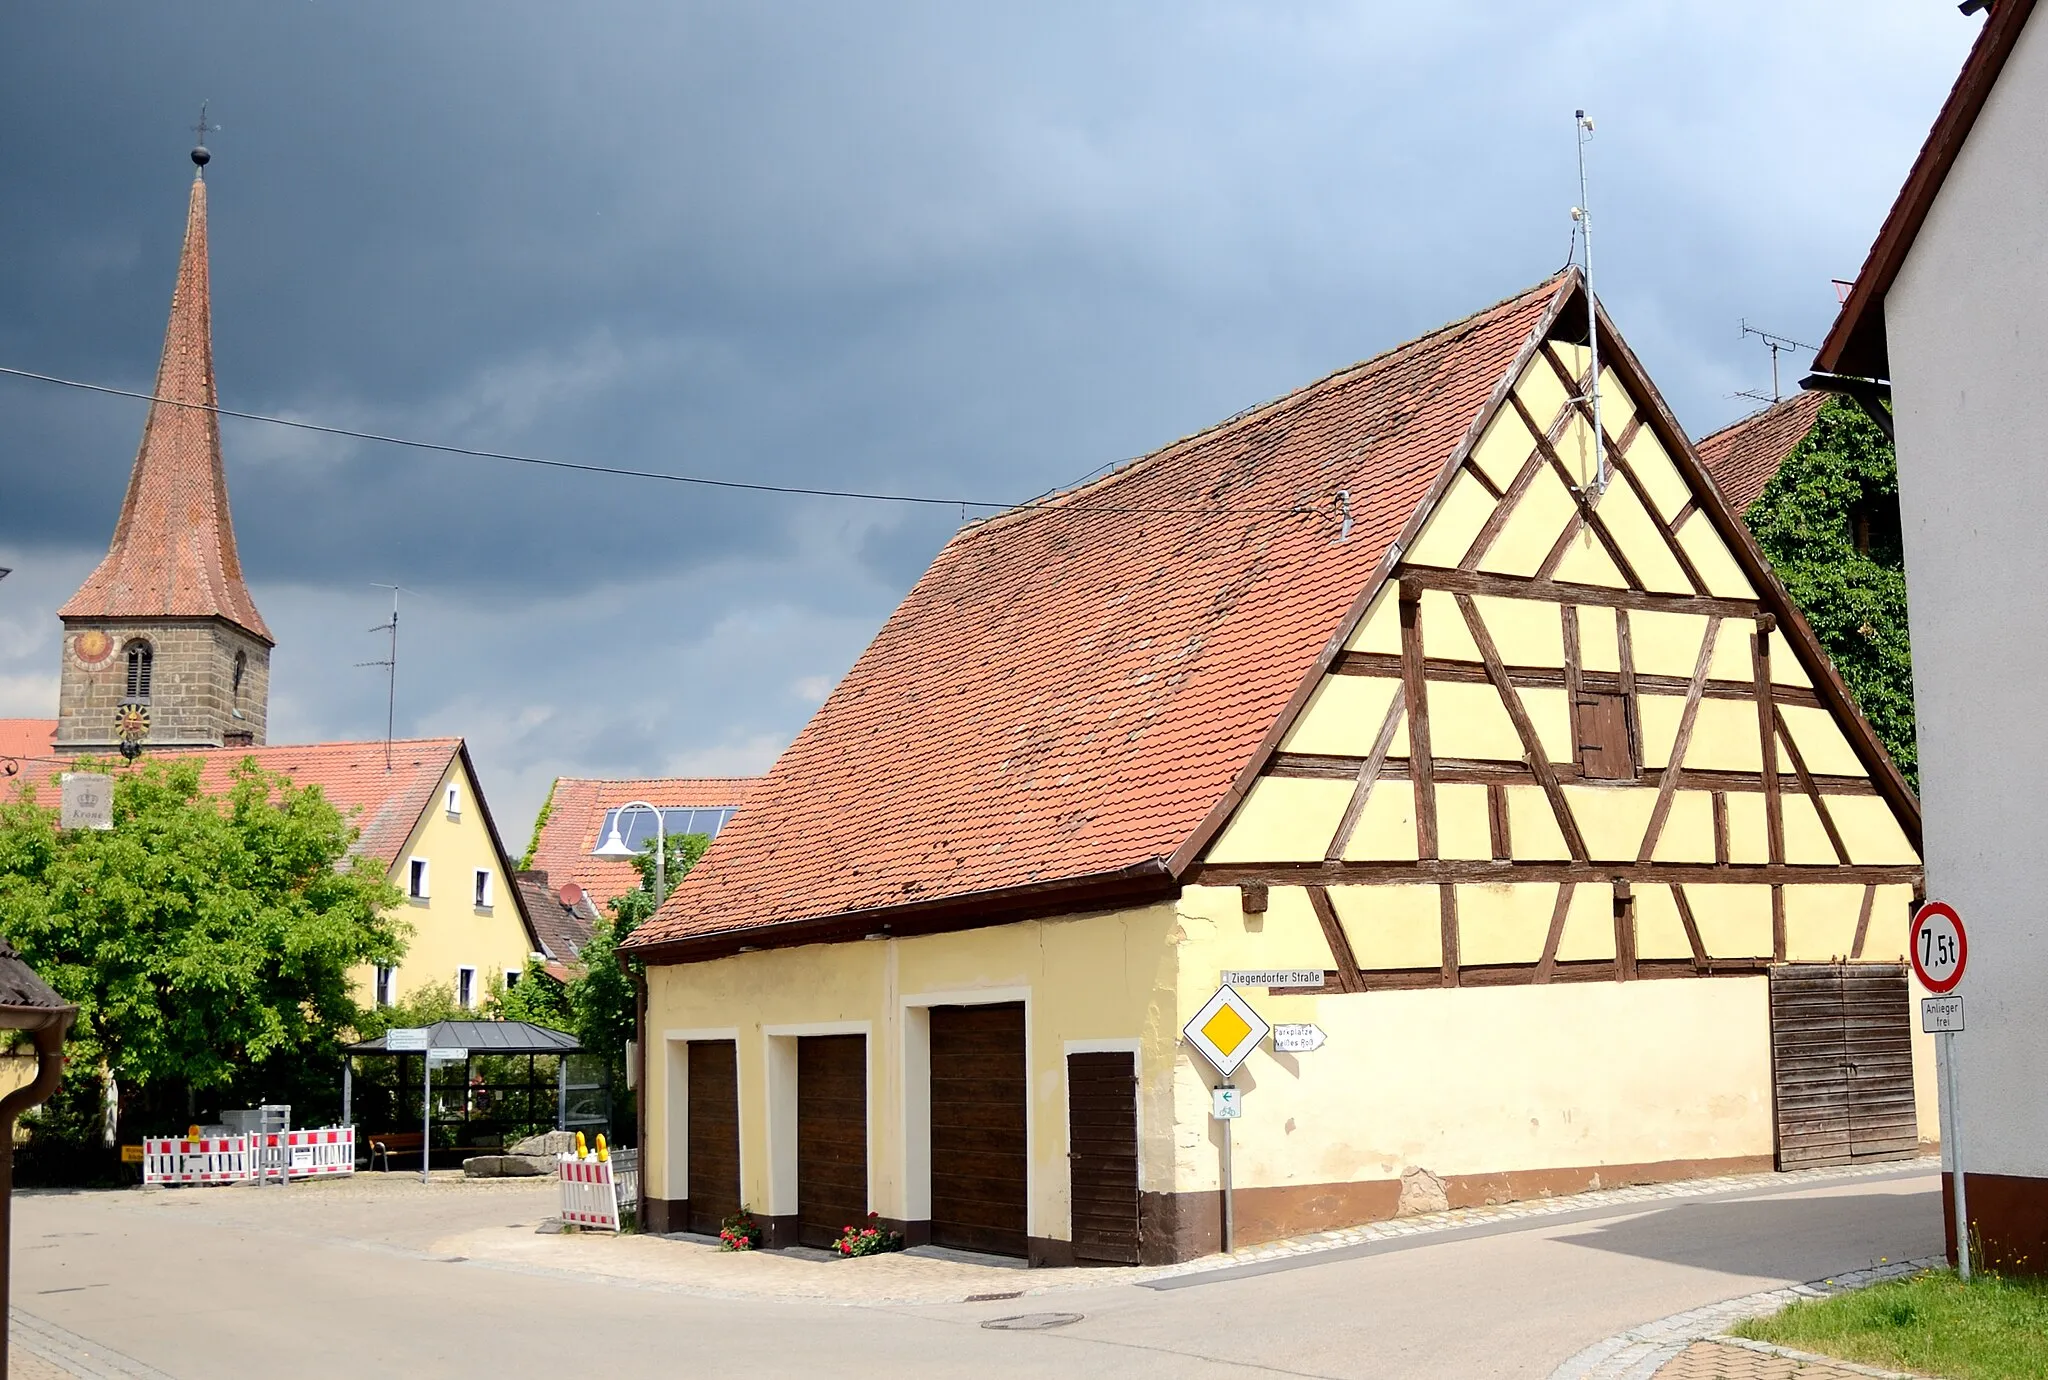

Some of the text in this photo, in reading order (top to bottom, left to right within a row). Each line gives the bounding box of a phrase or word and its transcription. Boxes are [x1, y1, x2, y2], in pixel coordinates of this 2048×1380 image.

[73, 810, 103, 819] Krone
[1921, 928, 1955, 967] 7,5t
[1231, 971, 1320, 985] Ziegendorfer Straße
[1926, 1003, 1958, 1015] Anlieger
[1936, 1016, 1950, 1027] frei
